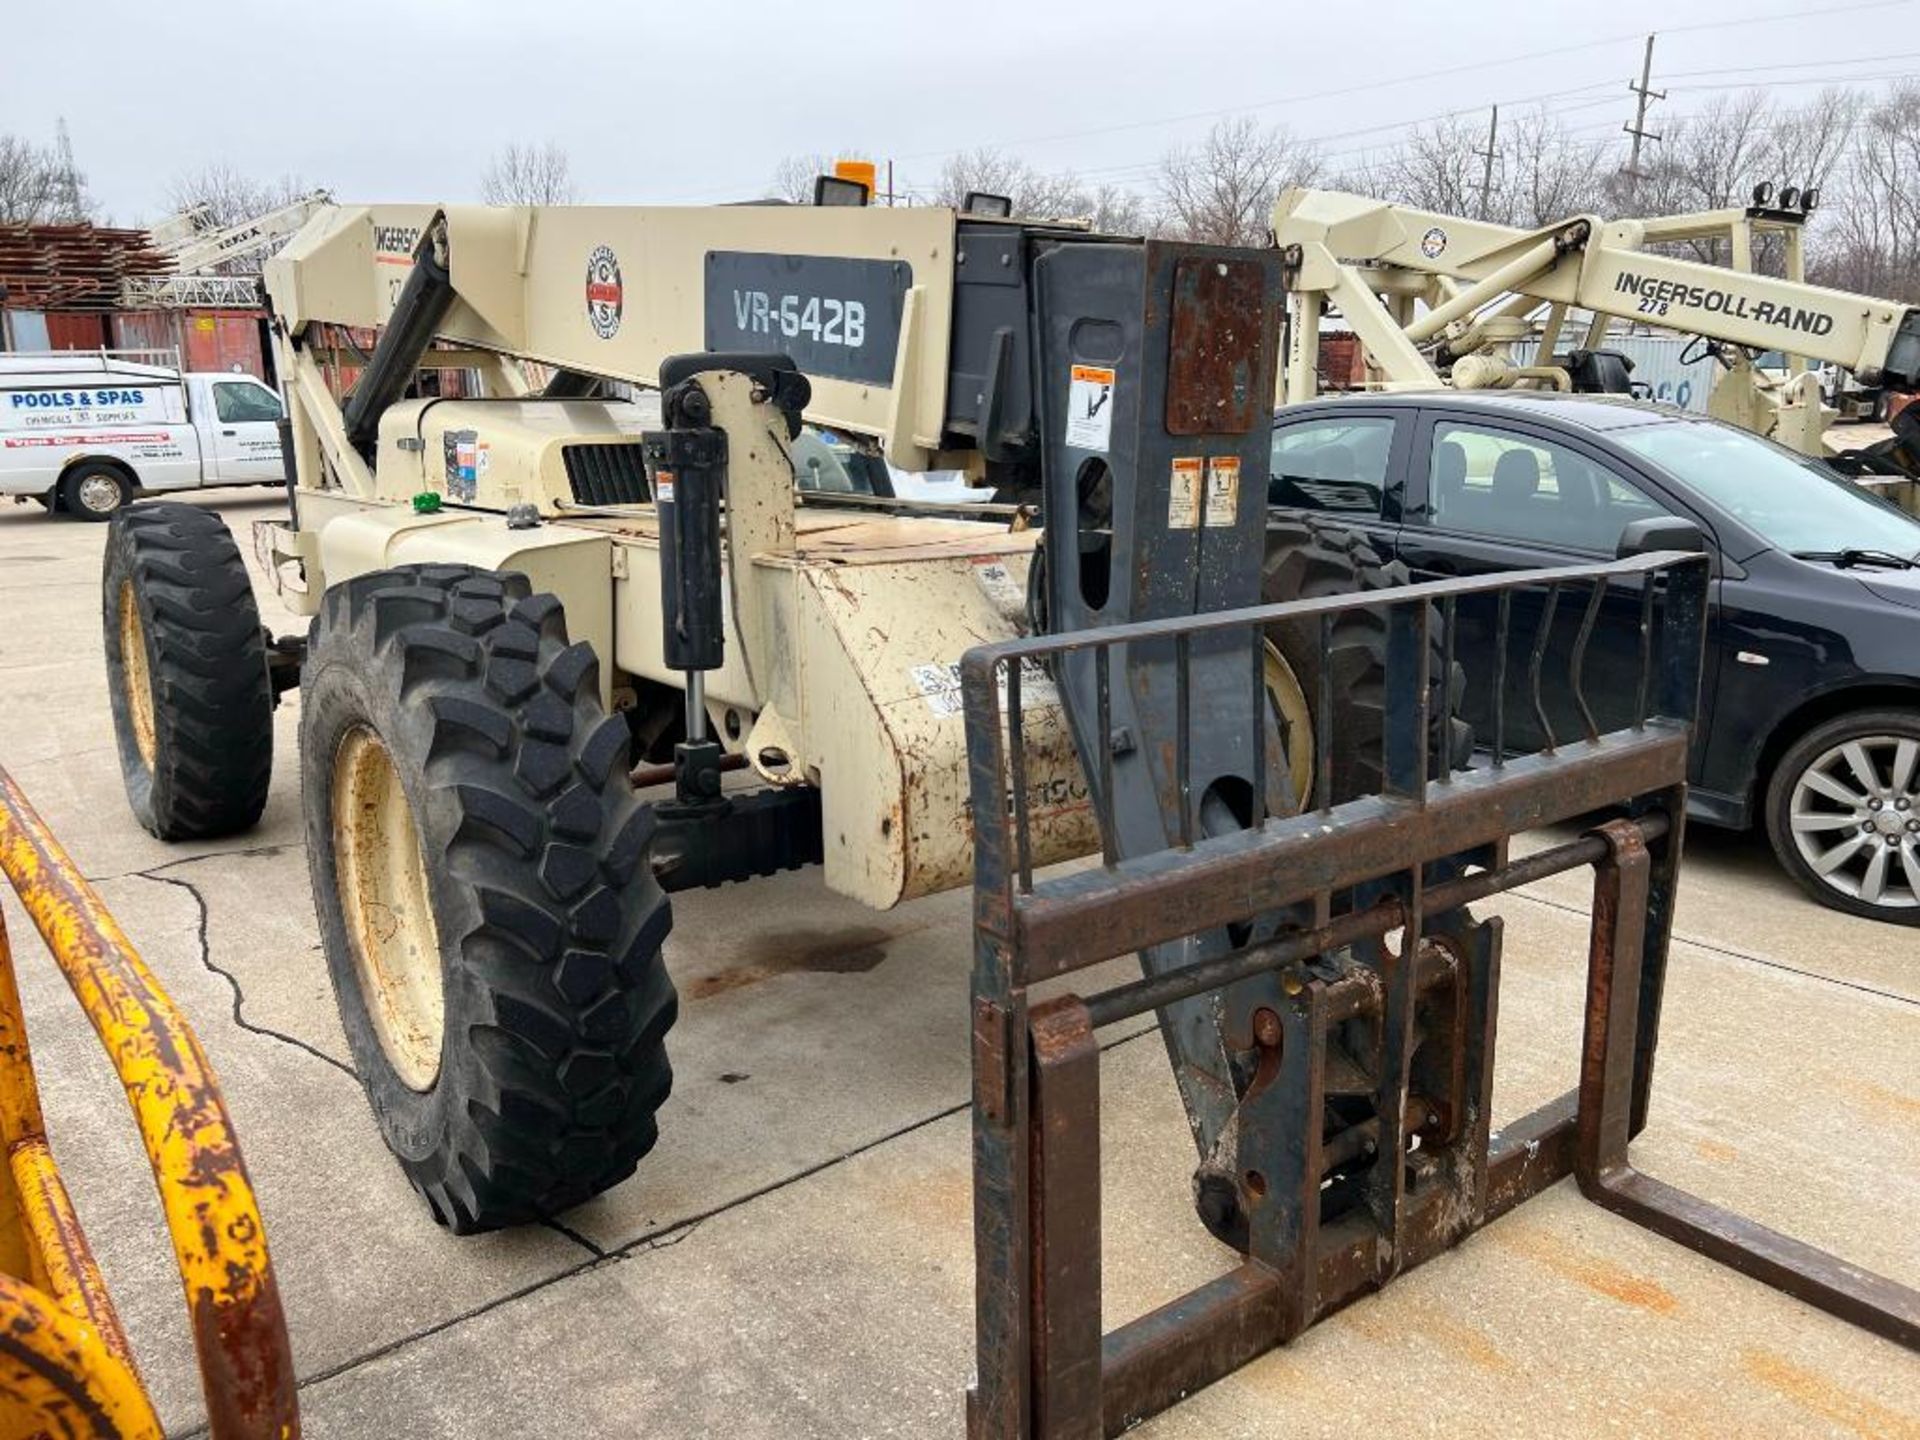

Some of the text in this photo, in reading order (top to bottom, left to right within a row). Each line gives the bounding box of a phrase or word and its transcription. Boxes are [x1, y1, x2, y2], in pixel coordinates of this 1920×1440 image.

[733, 289, 866, 347] VR-642B
[1614, 271, 1834, 336] INGERSOLL-RAND
[1637, 298, 1669, 317] 278
[12, 390, 144, 408] POOLS & SPAS
